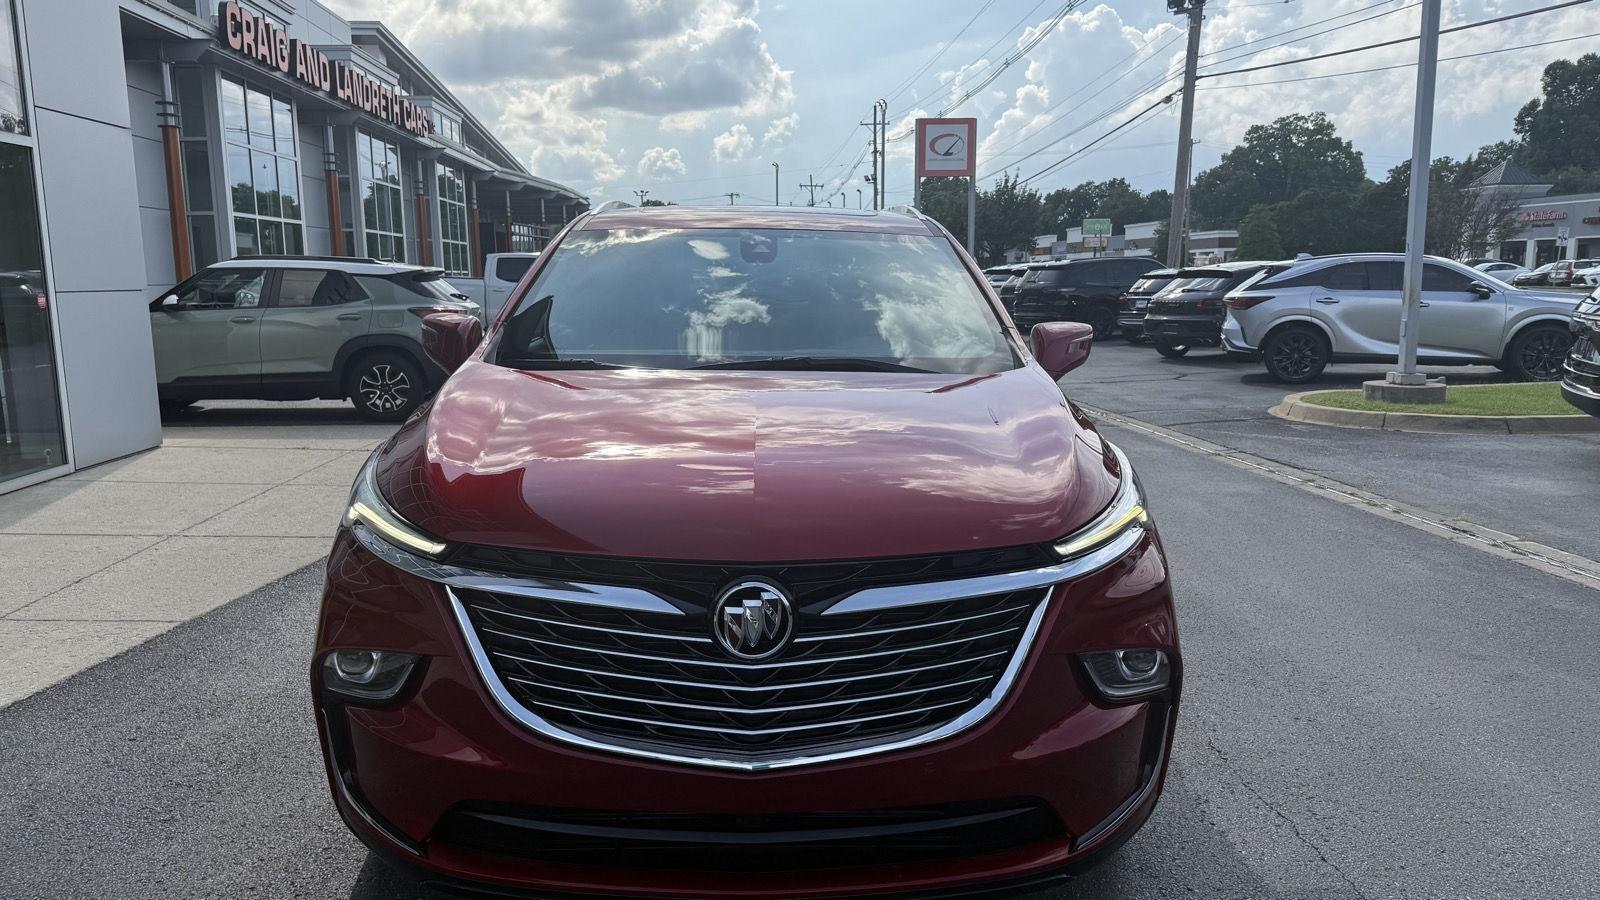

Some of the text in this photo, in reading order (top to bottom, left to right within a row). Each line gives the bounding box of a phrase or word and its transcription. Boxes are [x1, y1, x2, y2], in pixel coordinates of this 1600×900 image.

[225, 1, 429, 138] CRAIG AND LANDRETH CARS
